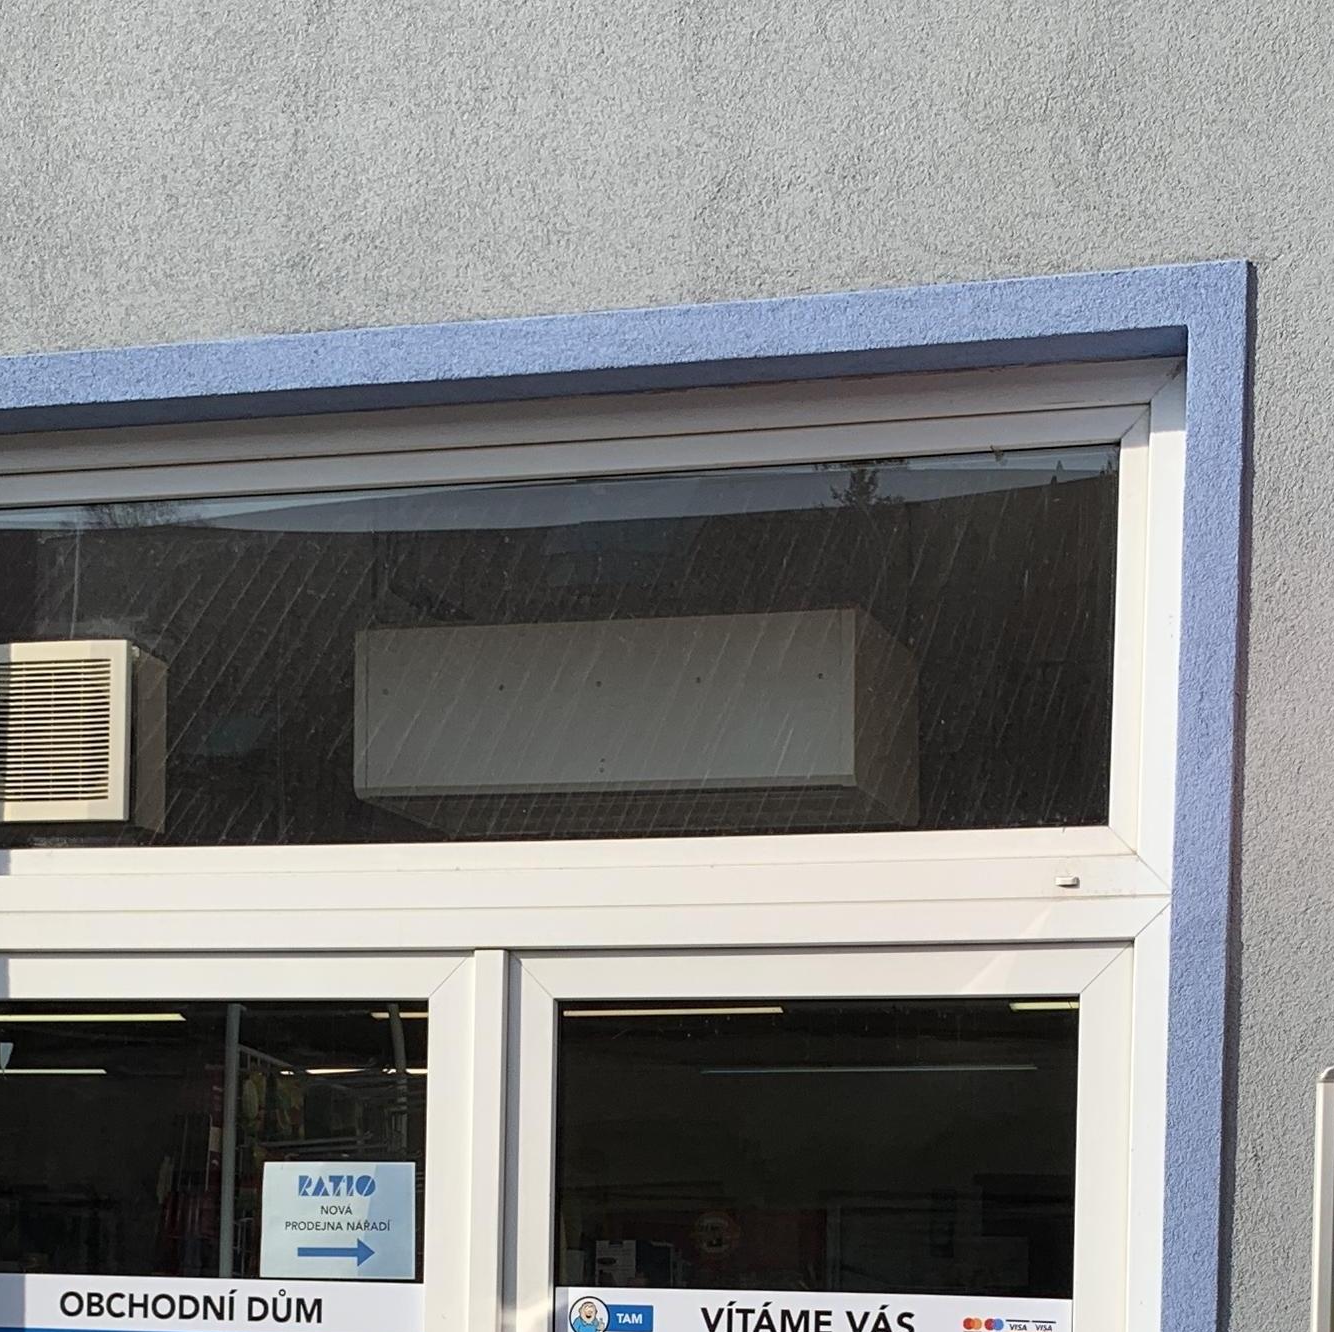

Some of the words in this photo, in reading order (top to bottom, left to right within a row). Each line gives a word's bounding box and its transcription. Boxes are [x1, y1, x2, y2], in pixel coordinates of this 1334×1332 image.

[298, 1175, 376, 1197] RATIO
[321, 1204, 353, 1215] NOVÁ
[285, 1221, 343, 1231] PRODEJNA
[347, 1219, 391, 1231] NÁŘADÍ
[60, 1289, 238, 1321] OBCHODNÍ
[247, 1289, 323, 1324] DŮM
[616, 1312, 643, 1326] TAM
[1009, 1323, 1027, 1331] VISA
[1035, 1324, 1053, 1332] VISA
